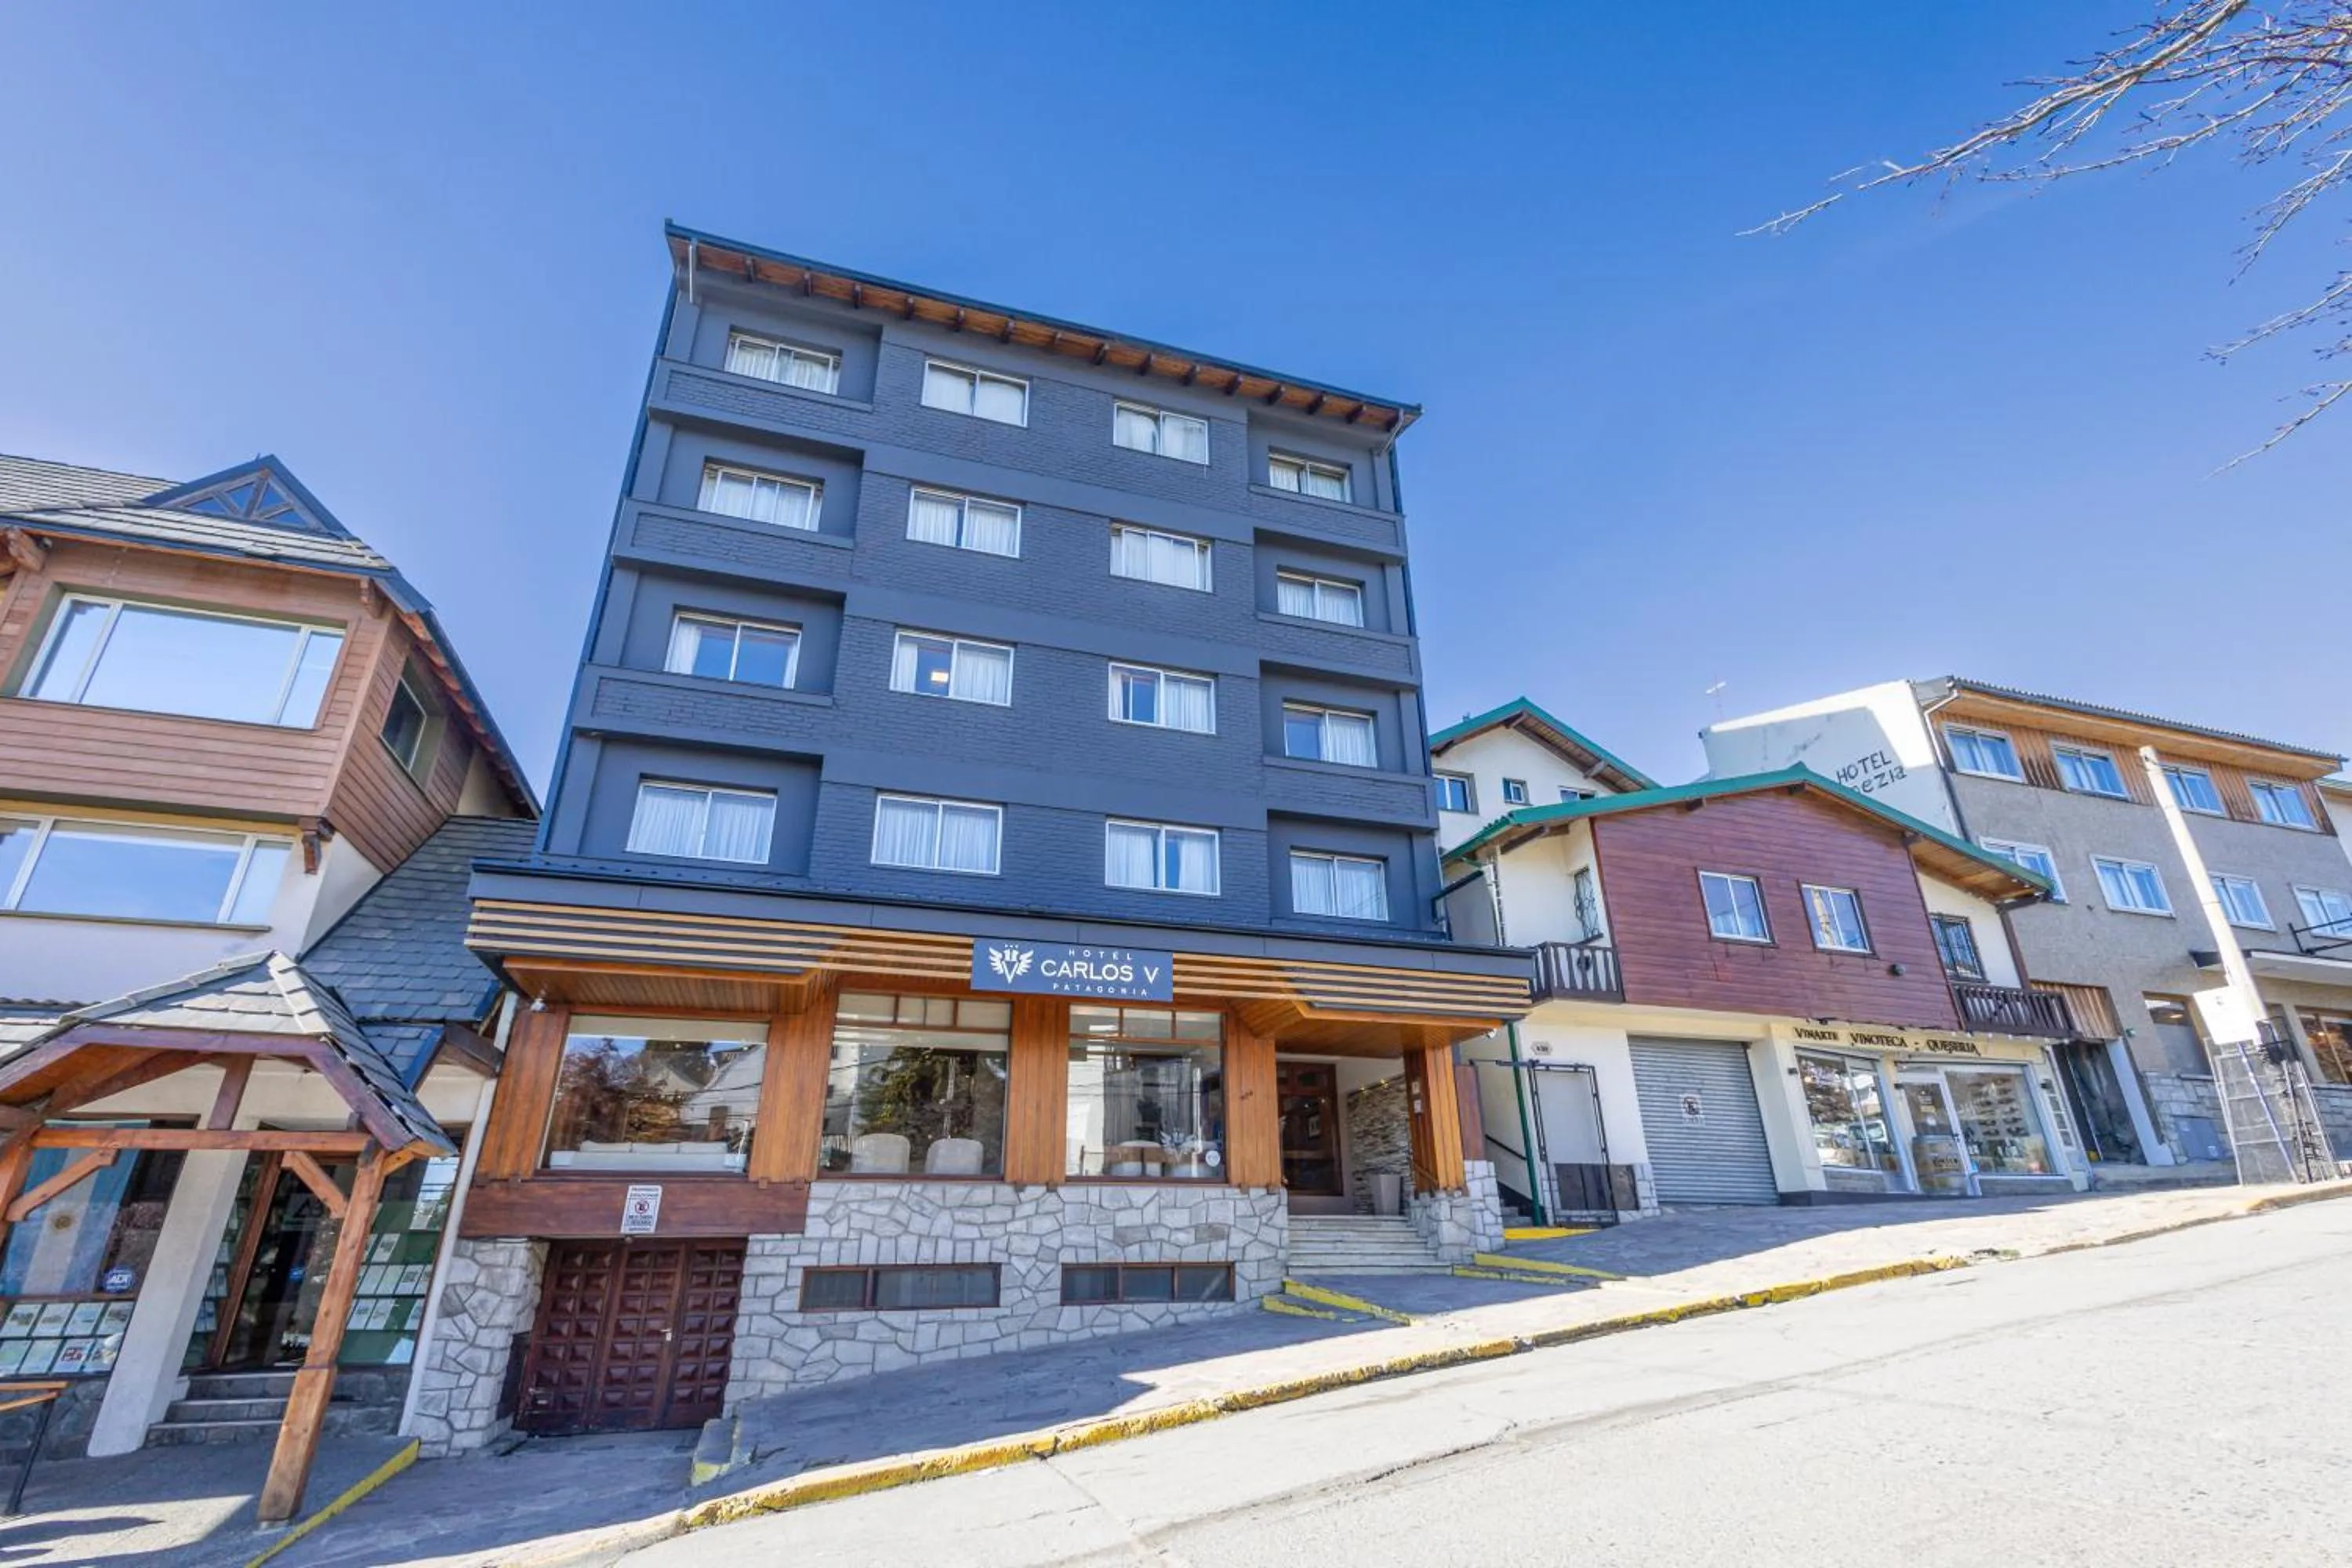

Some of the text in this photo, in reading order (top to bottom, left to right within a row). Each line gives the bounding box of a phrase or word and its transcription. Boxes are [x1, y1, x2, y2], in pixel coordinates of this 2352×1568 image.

[1836, 750, 1893, 784] HOTEL
[1069, 949, 1134, 961] HOTEL
[1040, 959, 1160, 984] CARLOS V
[1052, 982, 1149, 997] PATAGONIA
[1849, 1033, 1909, 1048] VINOTECA
